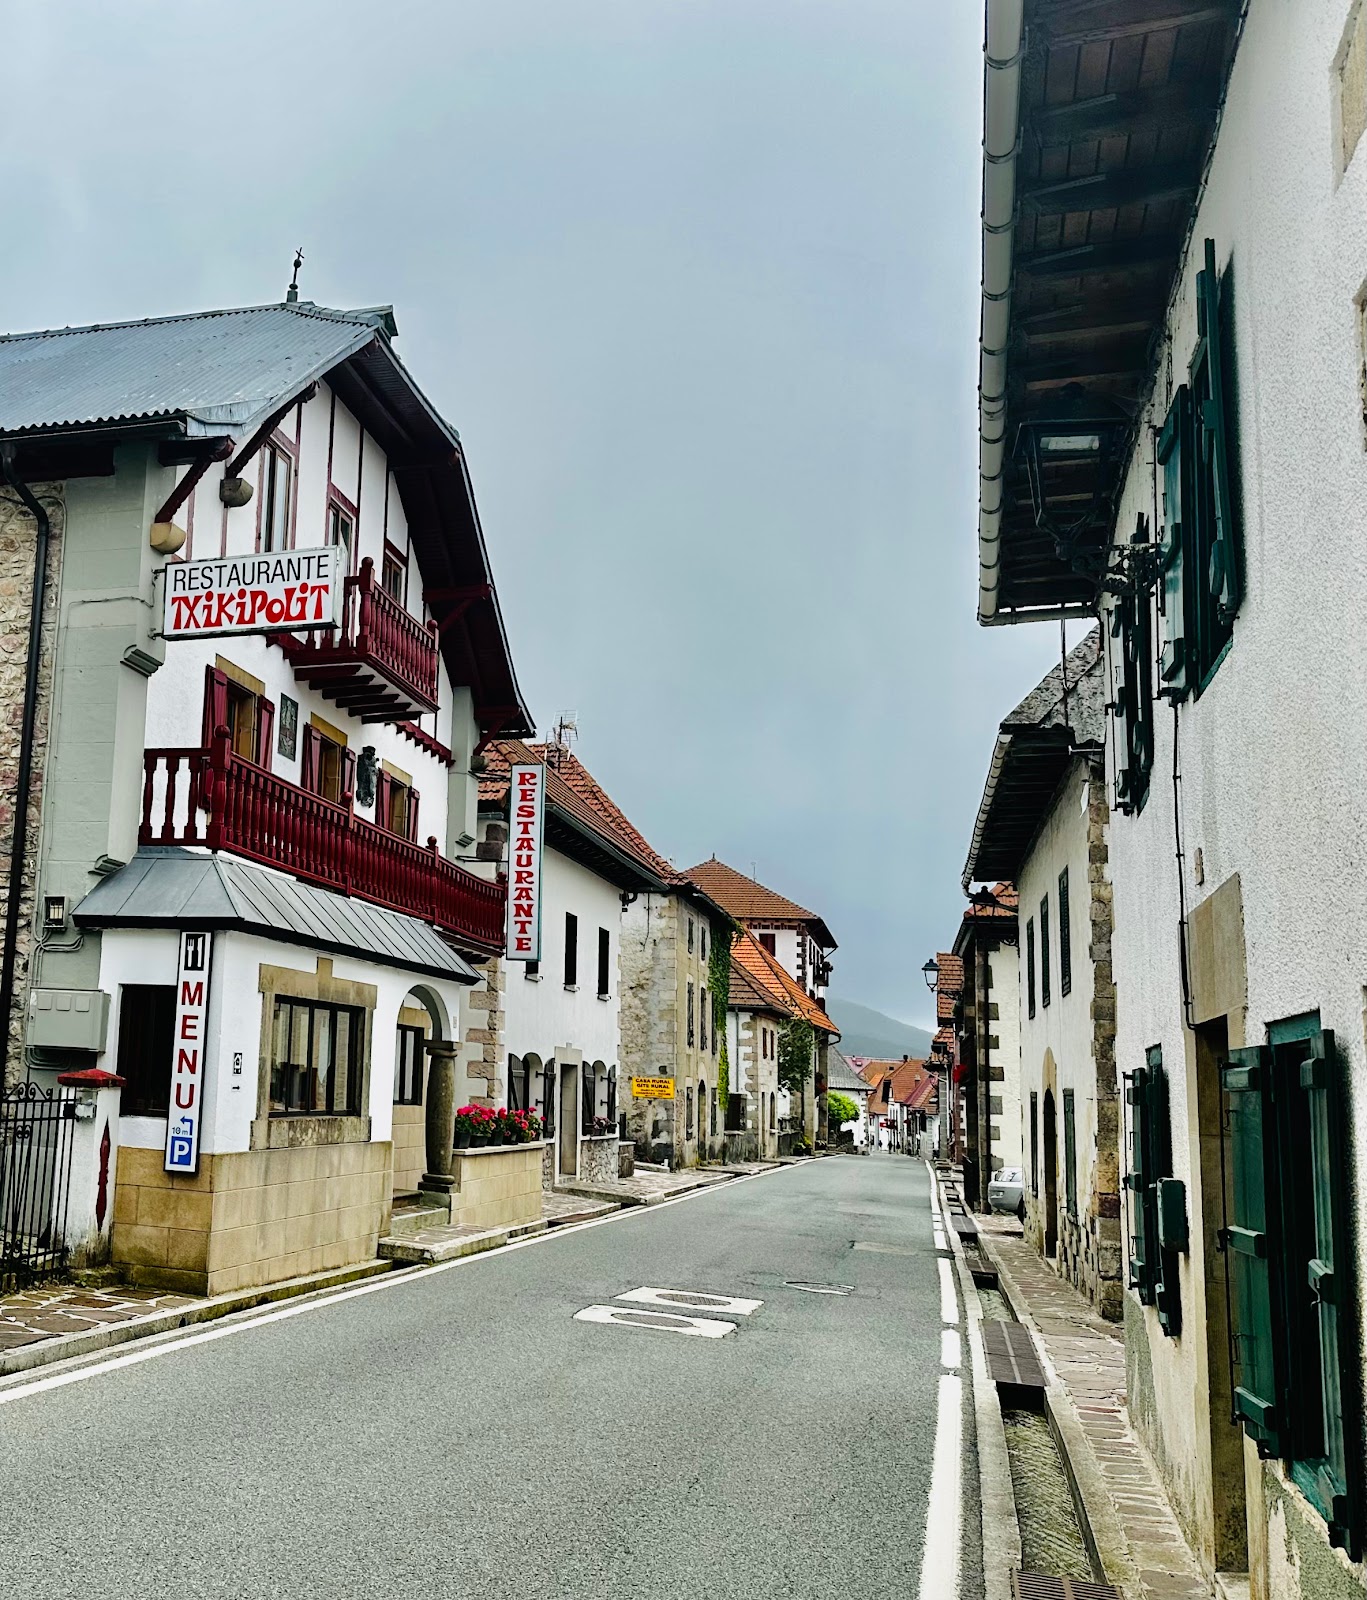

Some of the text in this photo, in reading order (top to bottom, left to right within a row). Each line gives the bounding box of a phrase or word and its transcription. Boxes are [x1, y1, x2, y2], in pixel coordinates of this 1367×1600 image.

[173, 554, 329, 592] RESTAURANTE
[513, 772, 538, 952] RESTAURANTE
[175, 981, 204, 1110] MENU
[173, 1140, 190, 1163] P
